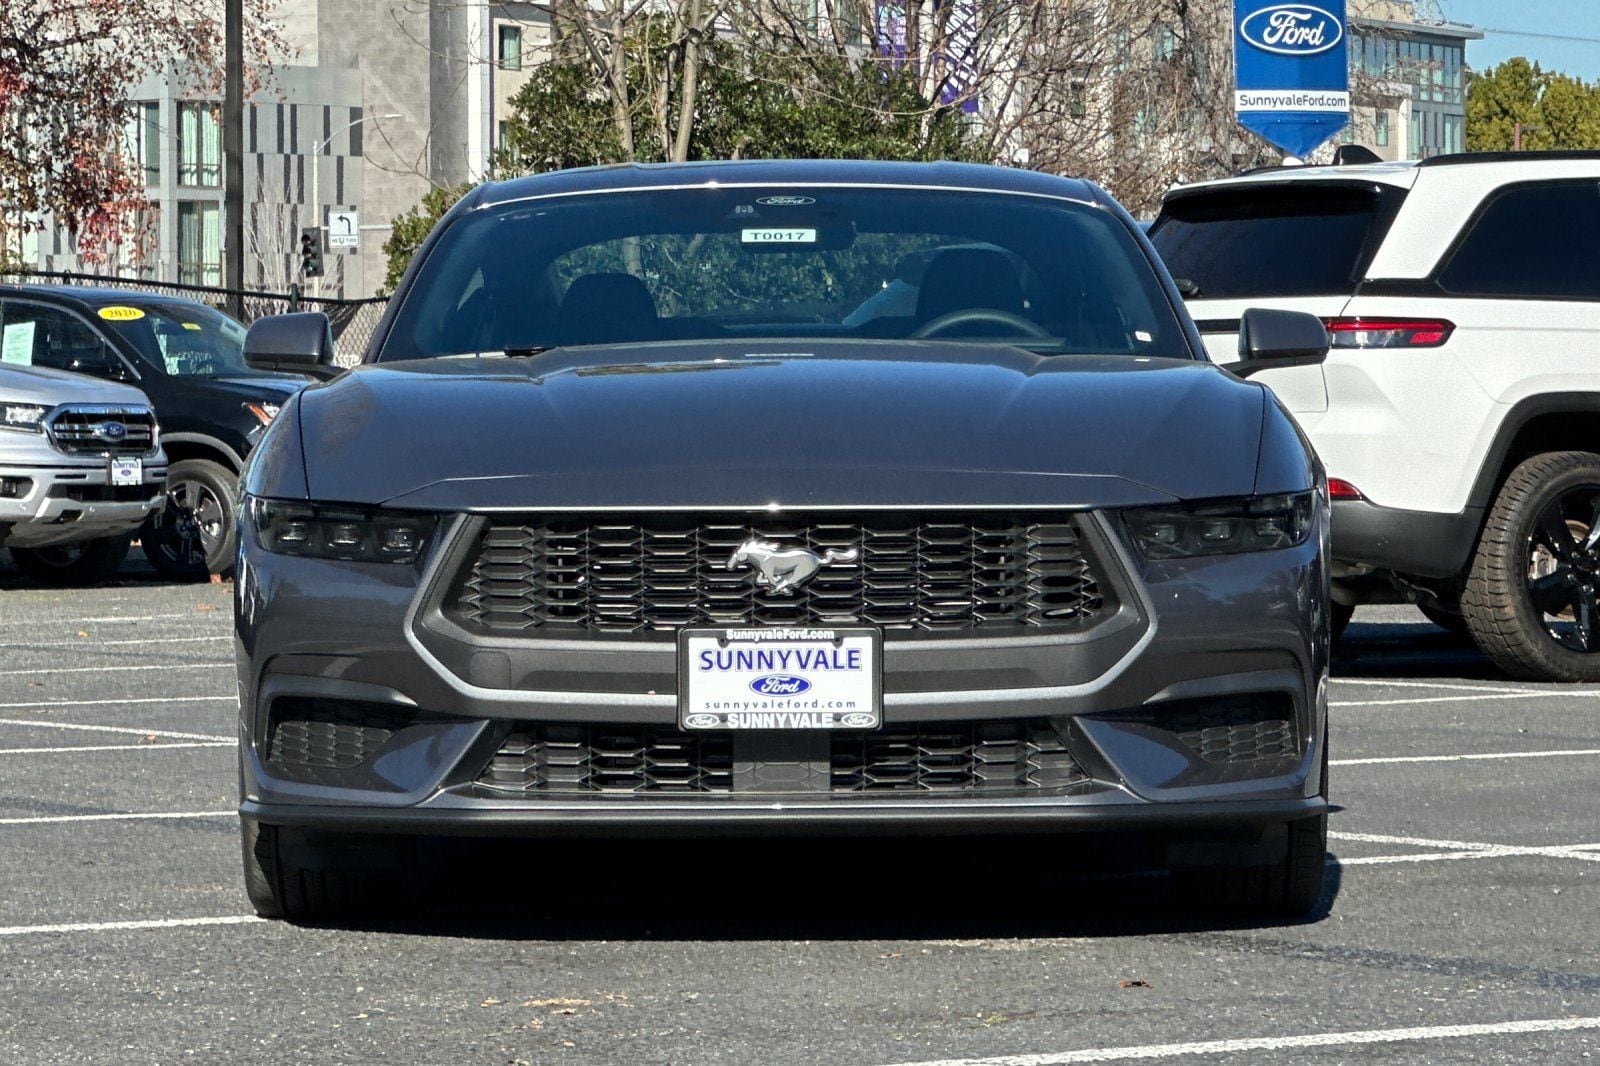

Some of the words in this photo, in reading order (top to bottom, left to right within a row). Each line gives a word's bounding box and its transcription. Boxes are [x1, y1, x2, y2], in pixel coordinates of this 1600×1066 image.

[1263, 10, 1325, 46] Ford
[1240, 94, 1346, 108] SunnyvaleFord.com
[766, 196, 806, 205] Ford
[750, 232, 805, 241] T0017
[109, 310, 137, 318] 2020
[726, 629, 835, 641] SunnyvaleFord.com
[699, 648, 862, 671] SUNNYVALE
[760, 676, 801, 693] Ford
[705, 699, 856, 710] sunnyvaleford.com
[727, 713, 834, 728] SUNNYVALE
